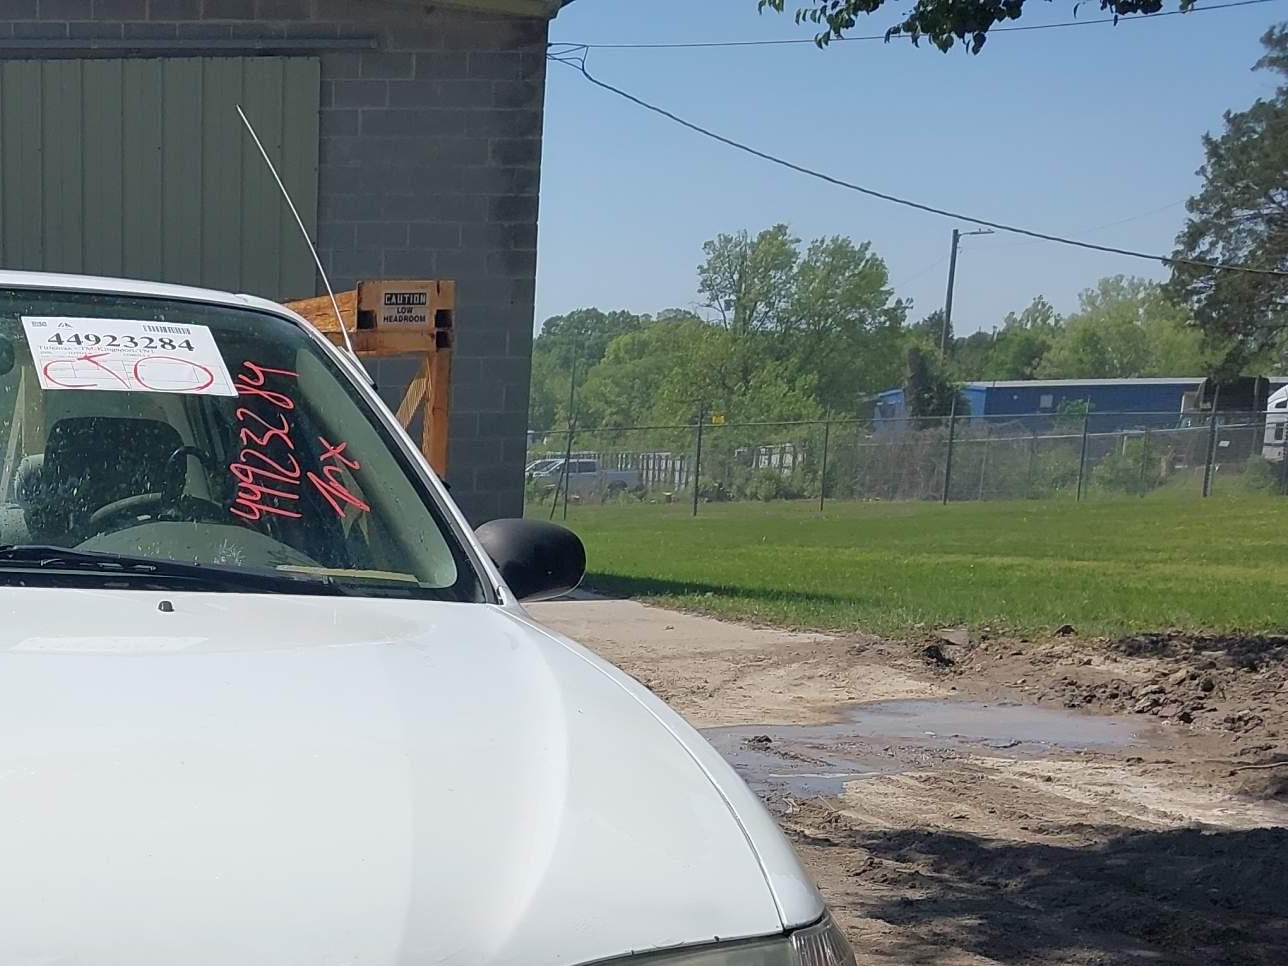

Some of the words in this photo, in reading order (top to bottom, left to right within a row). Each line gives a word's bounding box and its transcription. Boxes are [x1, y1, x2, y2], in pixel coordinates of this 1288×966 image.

[385, 293, 426, 305] CAUTION
[396, 306, 414, 314] LOW
[383, 315, 426, 323] HEADROOM
[47, 332, 195, 352] 44923284
[230, 360, 303, 520] 44923284
